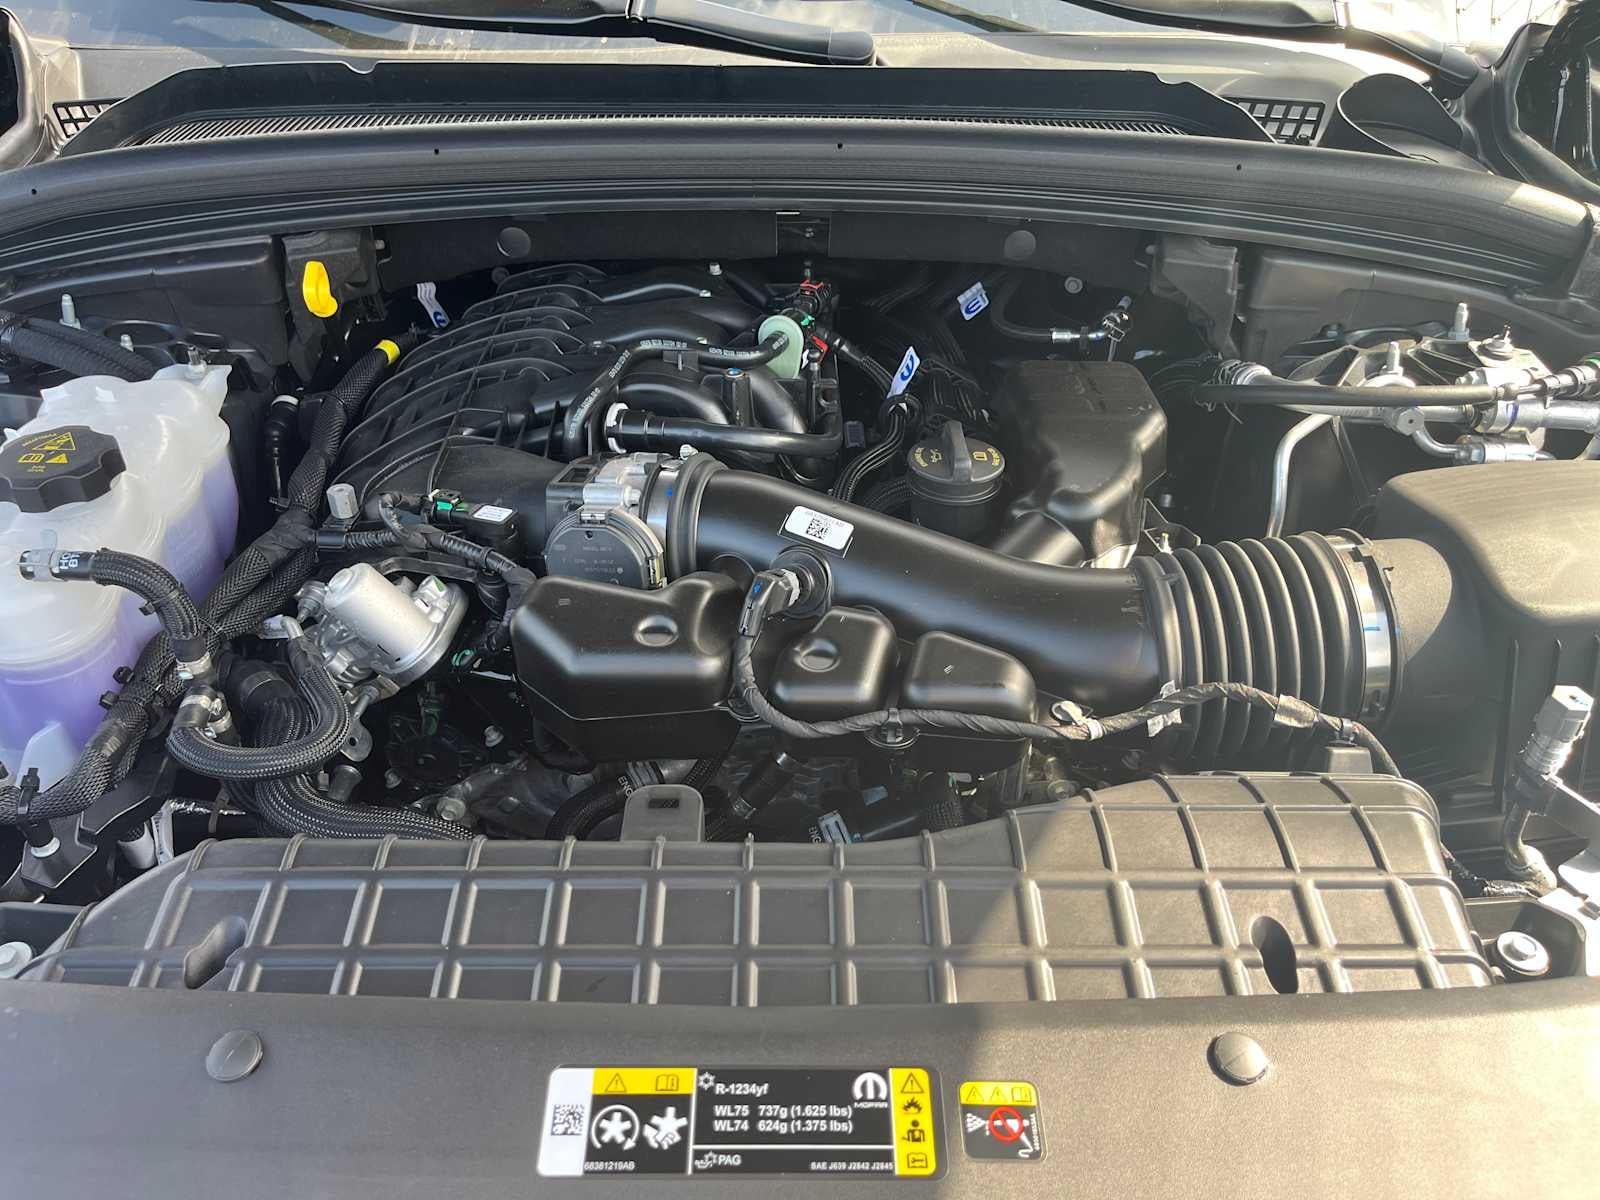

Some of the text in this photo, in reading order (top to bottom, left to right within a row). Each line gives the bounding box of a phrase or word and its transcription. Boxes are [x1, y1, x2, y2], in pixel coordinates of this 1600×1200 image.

[715, 1083, 769, 1097] R-1234yf
[714, 1104, 852, 1119] WL75 737g (1.625 lbs)
[714, 1119, 853, 1134] WL74 624g (1.375 lbs)
[718, 1154, 741, 1166] PAG
[810, 1161, 828, 1170] SAE
